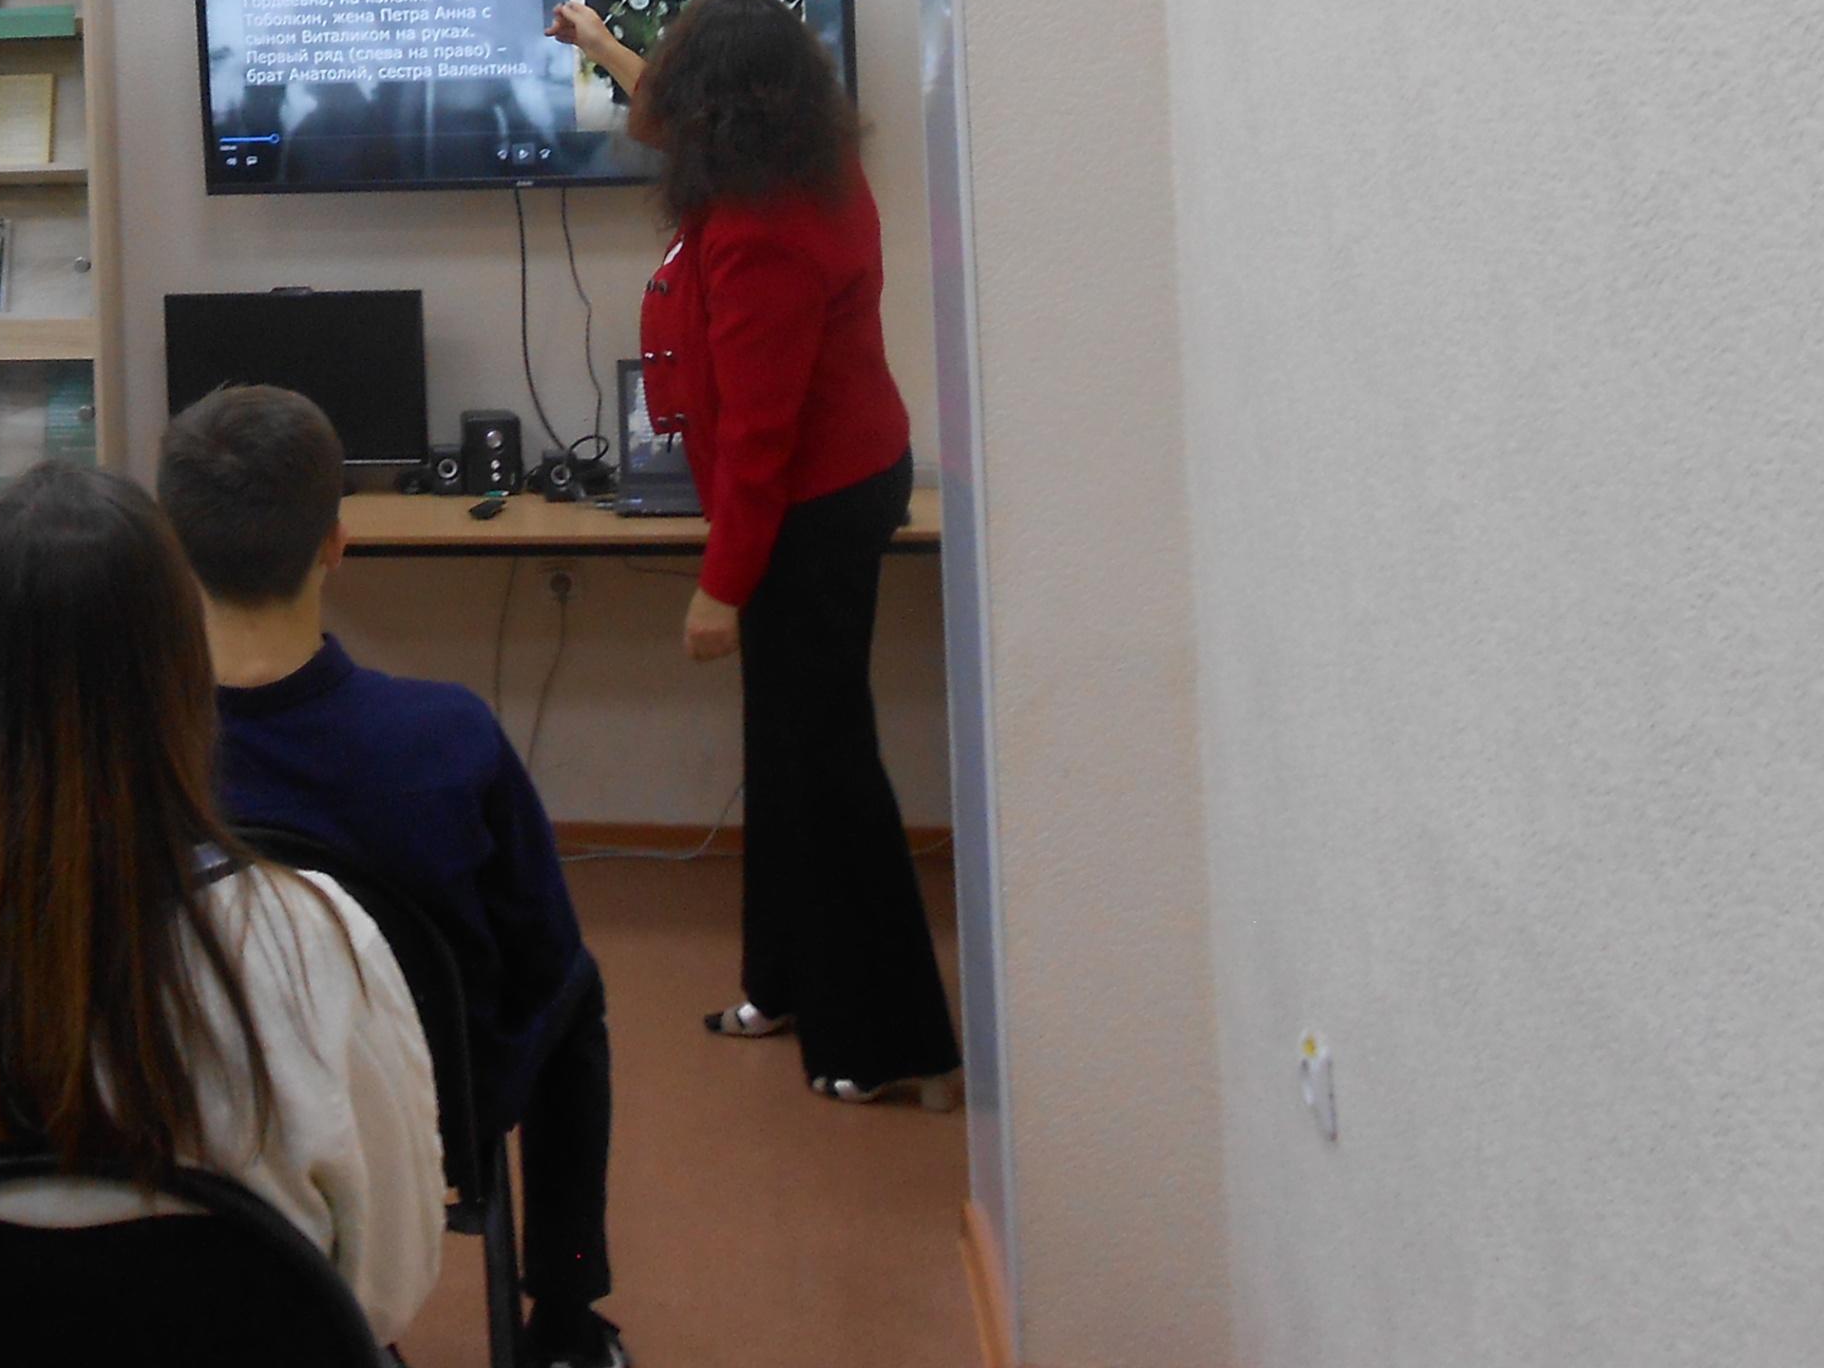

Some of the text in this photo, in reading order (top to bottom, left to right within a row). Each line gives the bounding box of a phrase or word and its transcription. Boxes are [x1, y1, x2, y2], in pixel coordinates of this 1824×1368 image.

[244, 12, 328, 27] Тоболкин,
[332, 11, 374, 25] жена
[379, 7, 429, 23] Петра
[434, 6, 476, 20] Анна
[245, 26, 475, 46] сыном Виталиком на руках.
[246, 48, 308, 66] Первый
[314, 49, 344, 64] ряд
[349, 47, 403, 64] (слева
[408, 46, 428, 59] на
[433, 42, 491, 60] право)
[246, 61, 533, 85] брат Анатолий, сестра Валентина.
